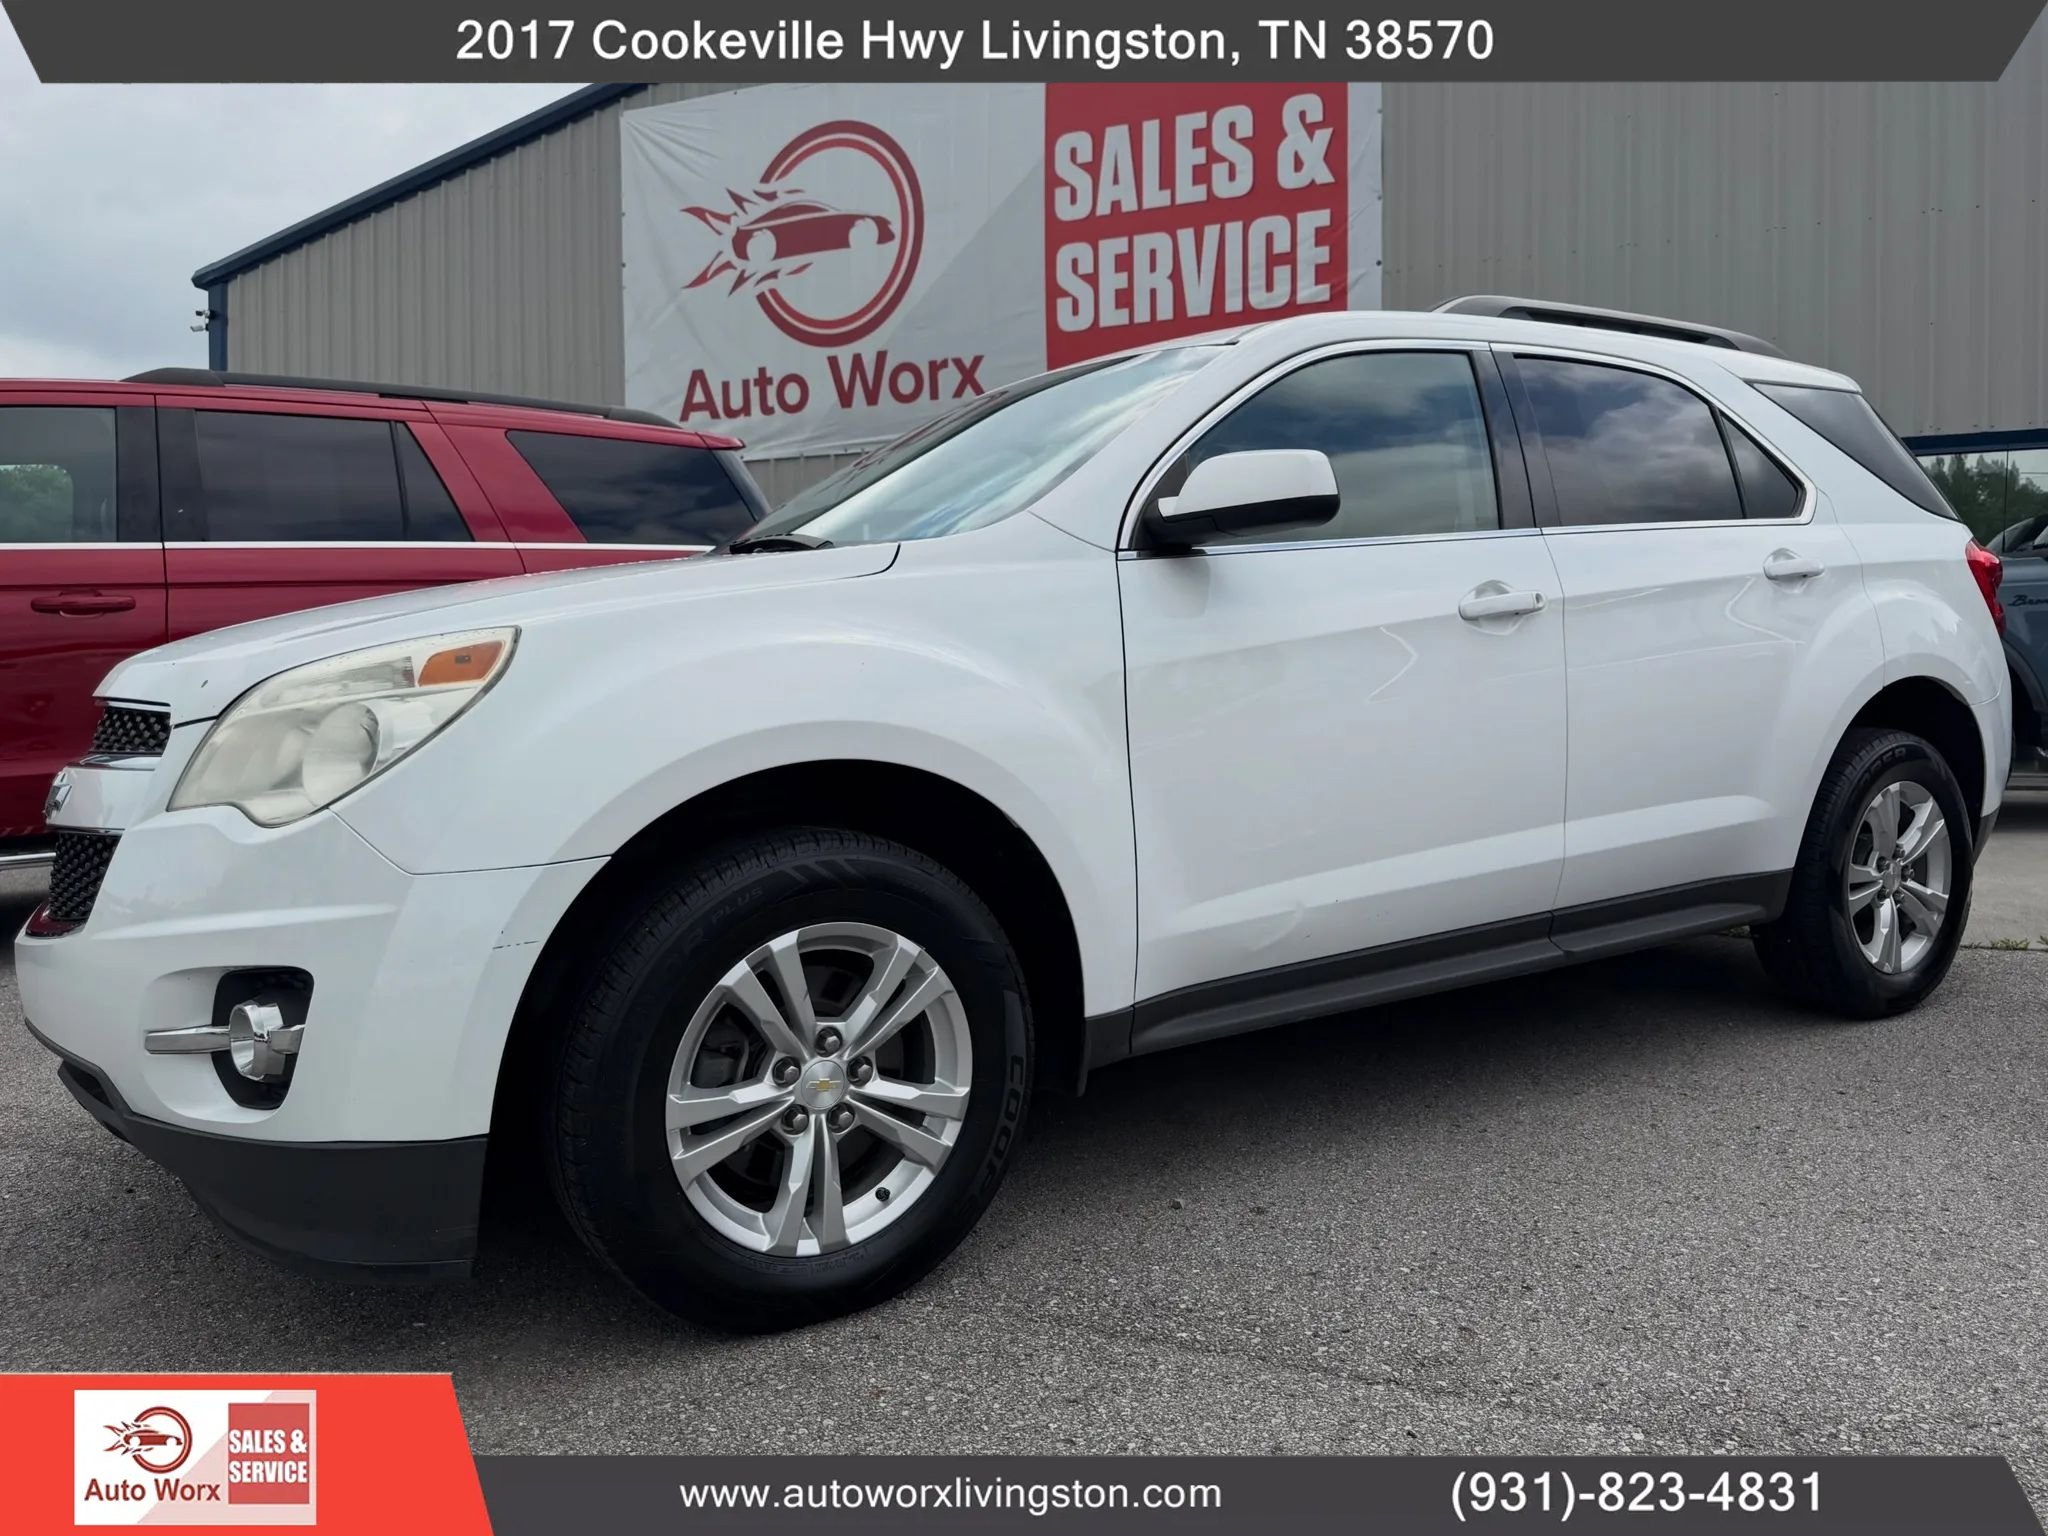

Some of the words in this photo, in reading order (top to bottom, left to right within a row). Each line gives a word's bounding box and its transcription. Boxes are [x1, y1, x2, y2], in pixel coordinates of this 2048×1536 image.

[1054, 104, 1254, 222] SALES
[1276, 93, 1334, 190] &
[1055, 210, 1331, 332] SERVICE
[678, 366, 809, 423] Auto
[827, 350, 985, 408] Worx
